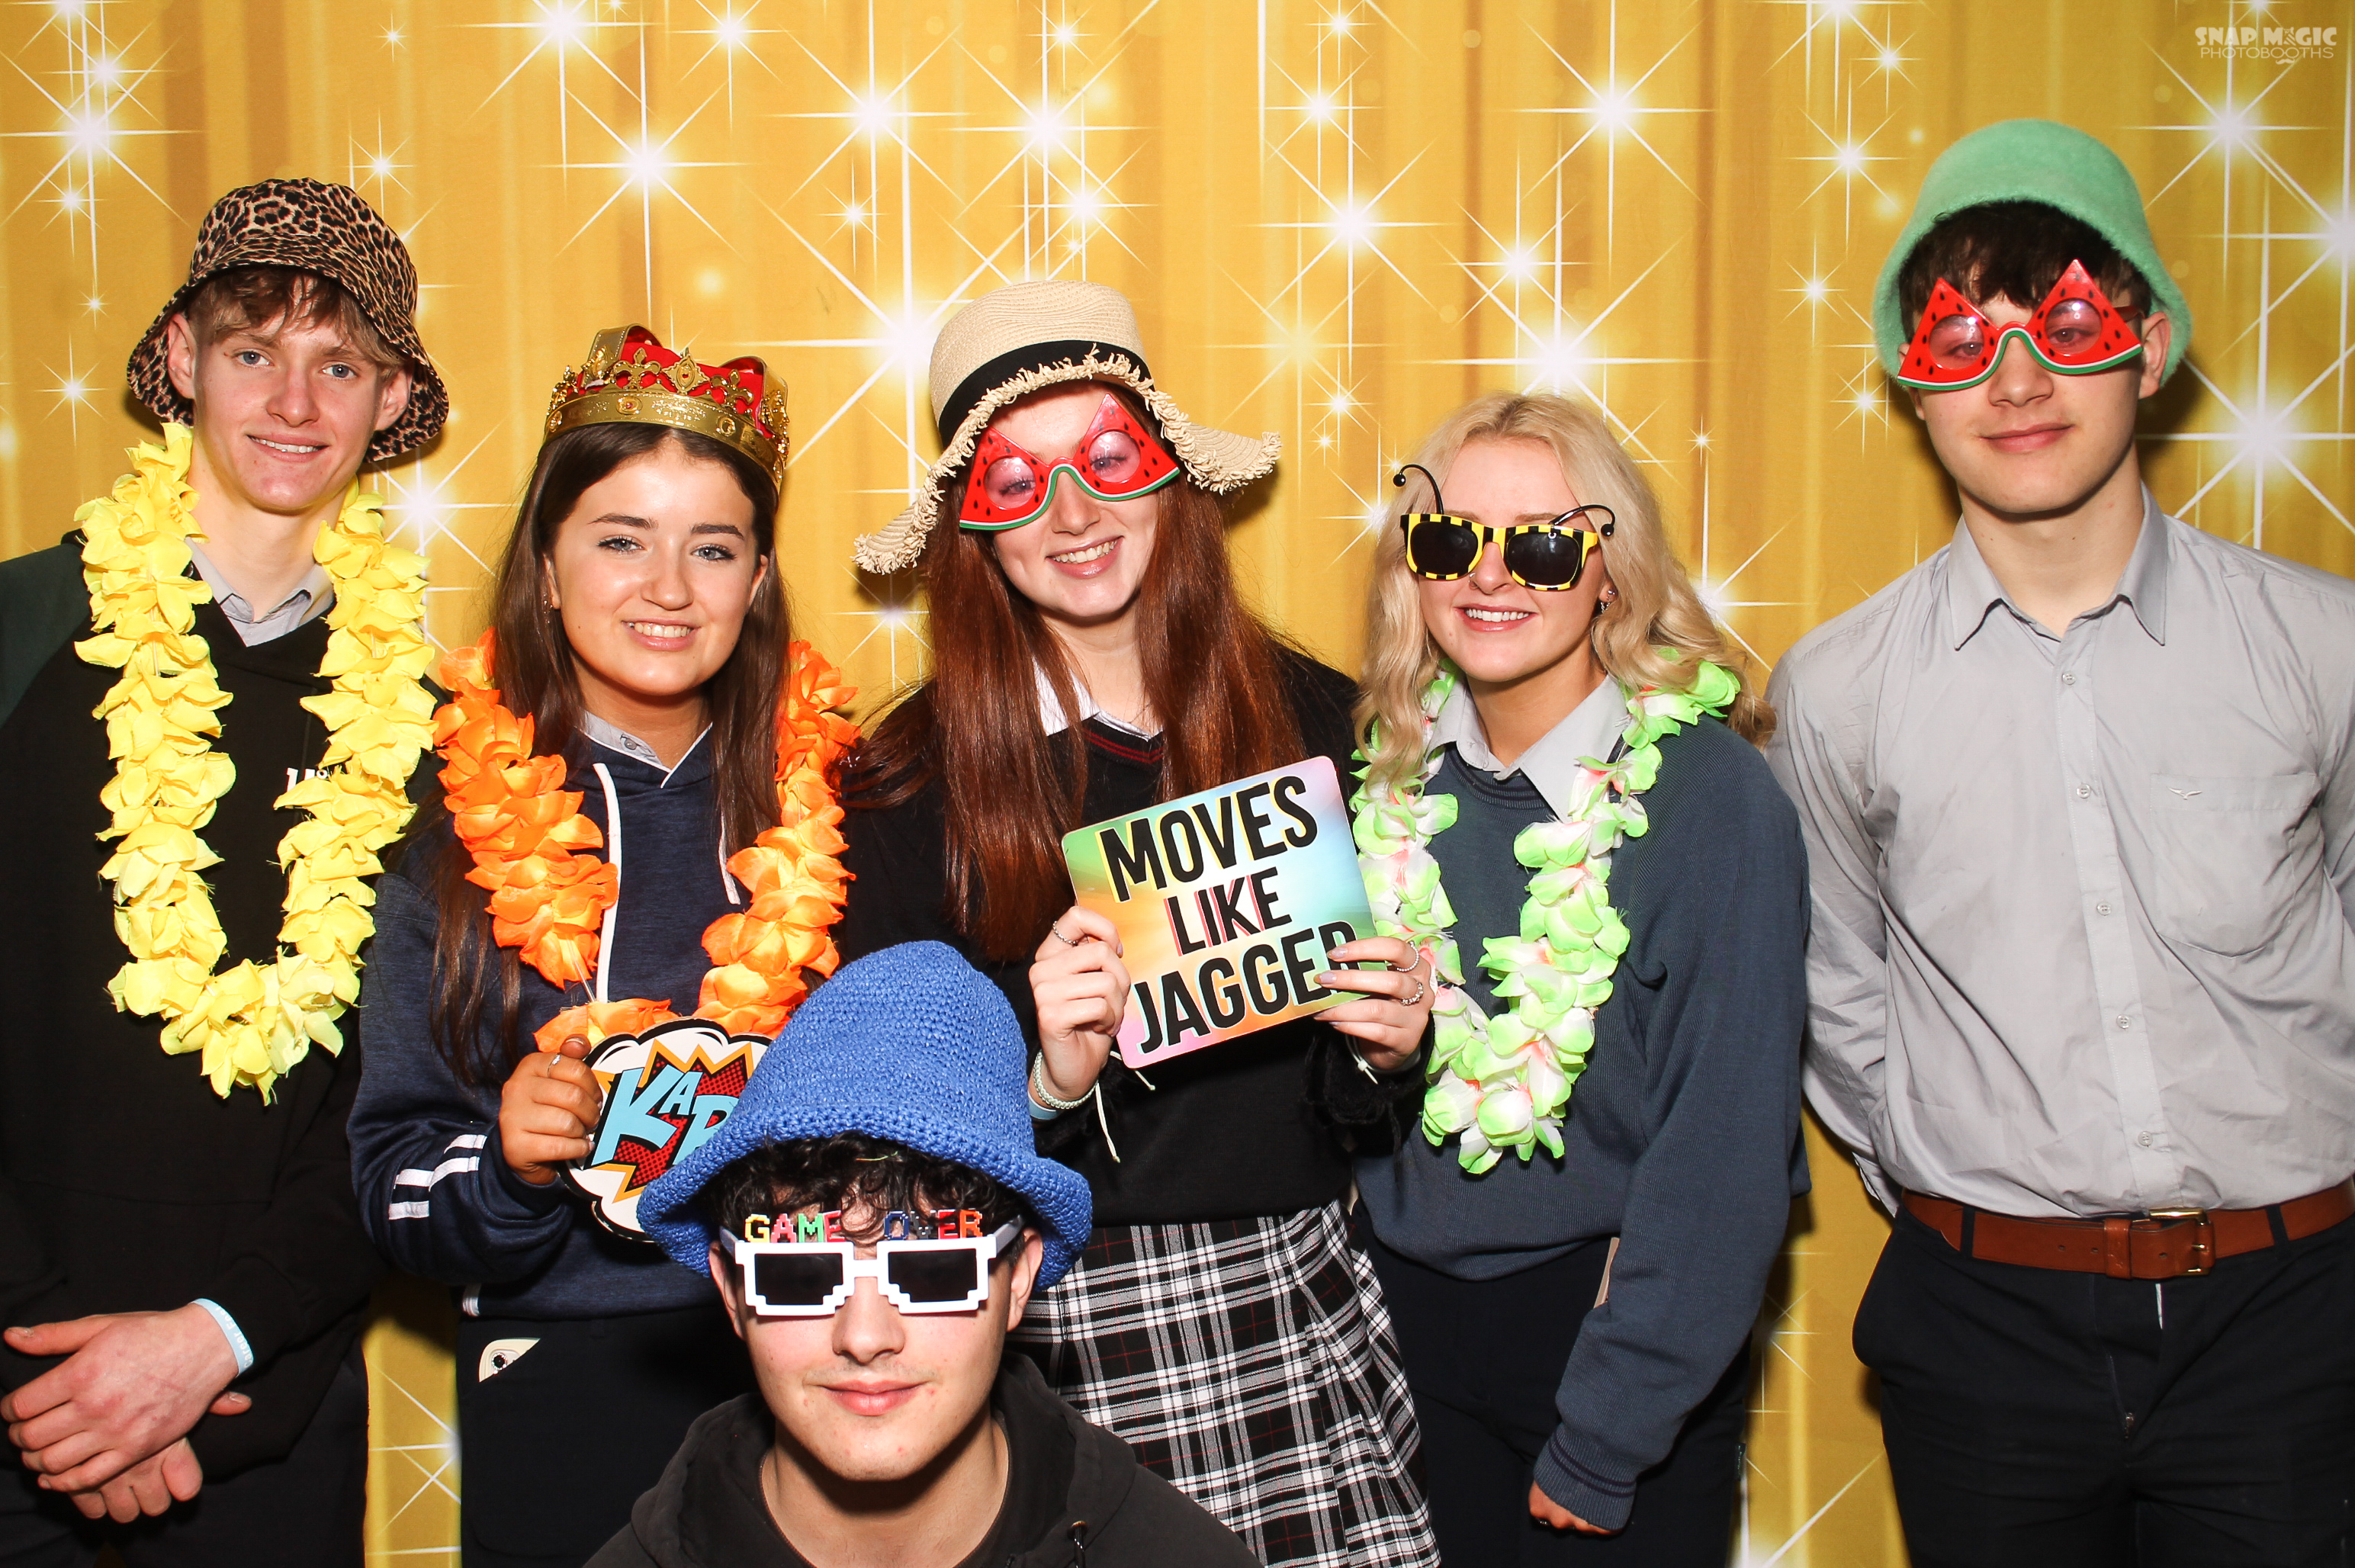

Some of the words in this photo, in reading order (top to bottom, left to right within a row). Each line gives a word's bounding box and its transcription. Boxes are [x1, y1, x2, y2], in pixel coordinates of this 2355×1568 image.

[1095, 776, 1319, 903] MOVES
[1163, 866, 1293, 956] LIKE
[1133, 921, 1362, 1055] JAGGER
[744, 1210, 846, 1242] GAME
